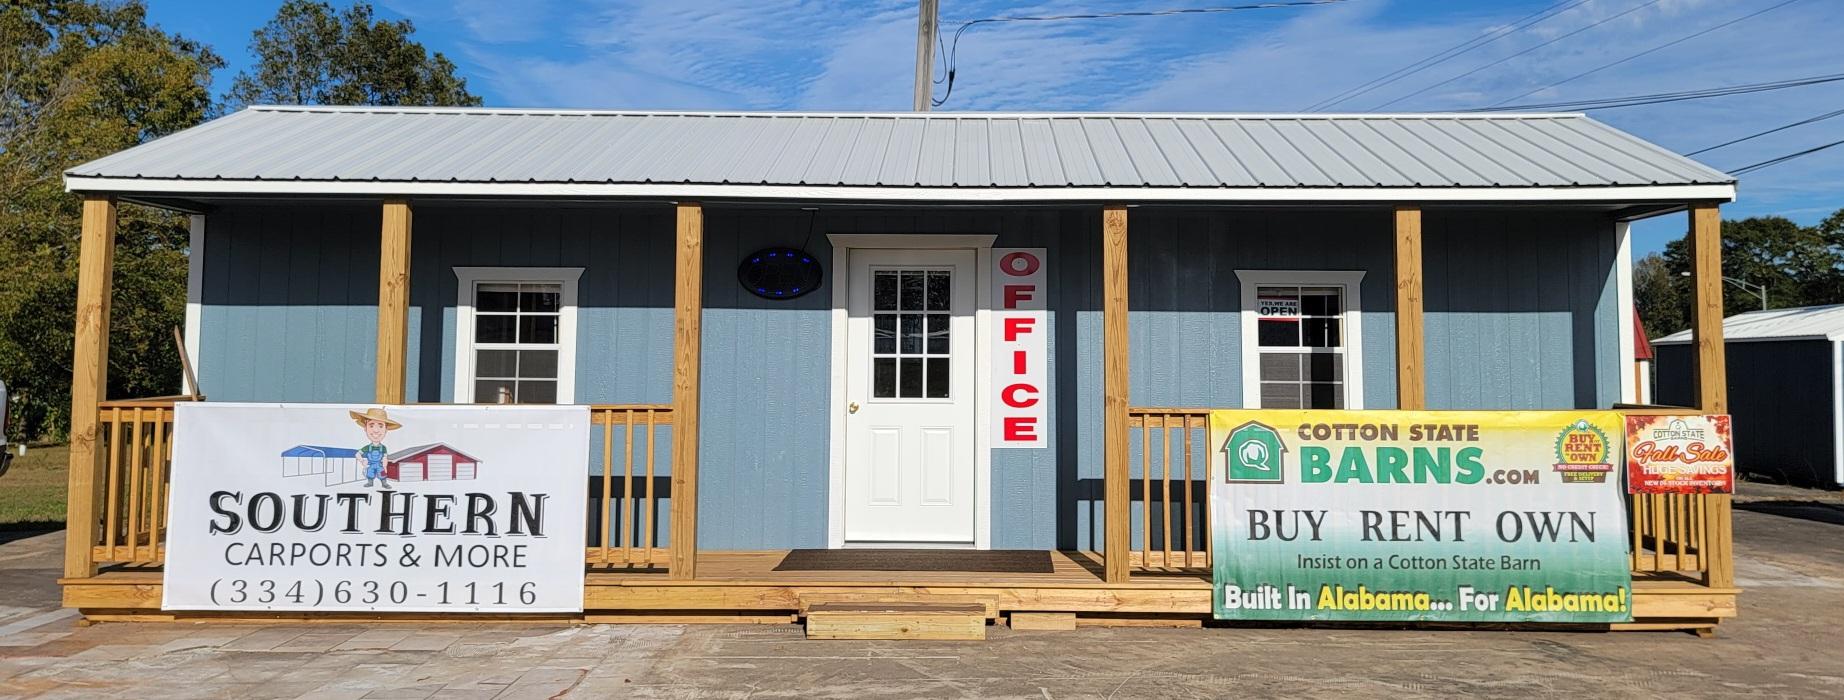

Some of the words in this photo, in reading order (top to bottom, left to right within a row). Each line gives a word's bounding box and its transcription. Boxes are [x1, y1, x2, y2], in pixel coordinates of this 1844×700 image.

[1260, 307, 1297, 316] OPEN
[999, 251, 1040, 441] OFFICE
[1298, 423, 1399, 441] COTTON
[1409, 424, 1479, 442] STATE
[1569, 434, 1595, 443] BUY
[1653, 430, 1680, 440] COTTON
[1681, 430, 1704, 440] STATE
[1564, 443, 1601, 452] RENT
[1570, 453, 1597, 461] OWN
[1633, 441, 1679, 464] Fall
[1680, 442, 1728, 464] Sale
[1643, 465, 1677, 475] HUGE
[1679, 465, 1727, 475] SAVINGS
[208, 489, 551, 538] SOUTHERN
[1246, 509, 1327, 542] BUY
[1360, 510, 1471, 542] RENT
[1495, 510, 1597, 543] OWN
[224, 542, 388, 567] CARPORTS
[399, 542, 421, 568] &
[434, 544, 528, 568] MORE
[1298, 553, 1342, 570] Insist
[1347, 557, 1368, 570] on
[1373, 557, 1383, 570] a
[1388, 555, 1447, 571] Cotton
[1451, 555, 1496, 571] State
[1500, 555, 1541, 571] Barn
[209, 578, 538, 608] (334)630-1116
[1224, 584, 1283, 611] Built
[1287, 587, 1311, 611] In
[1317, 586, 1453, 612] Alabama...
[1459, 588, 1500, 613] For
[1505, 587, 1628, 613] Alabama!
